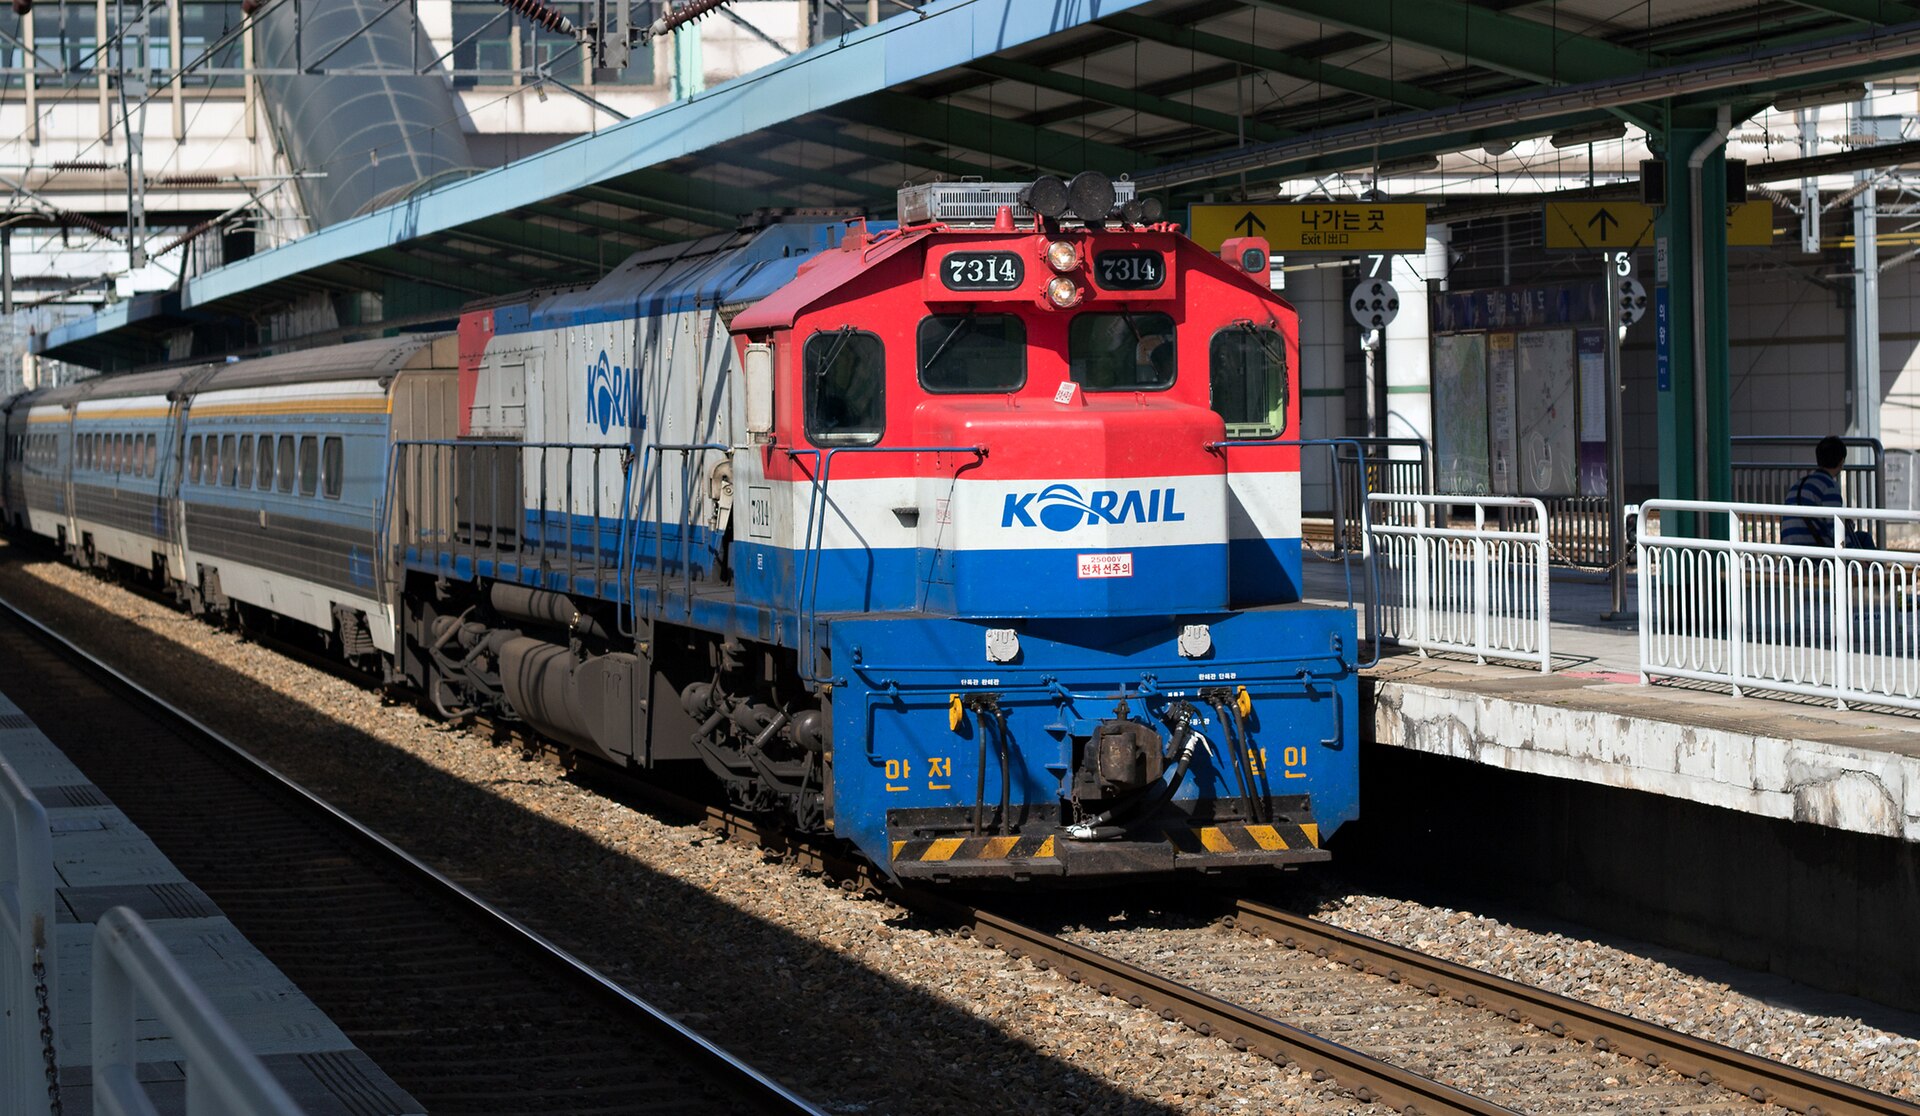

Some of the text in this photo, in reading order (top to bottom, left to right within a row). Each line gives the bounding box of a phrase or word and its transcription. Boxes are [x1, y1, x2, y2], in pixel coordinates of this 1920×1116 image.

[1301, 209, 1385, 231] 나가는 곳
[1301, 232, 1321, 245] Exit
[1327, 232, 1349, 245] 出口
[950, 256, 1016, 282] 7314
[1102, 257, 1155, 281] 7314
[1367, 254, 1384, 278] 7
[1614, 251, 1631, 277] 6
[587, 349, 647, 436] KORAIL
[751, 499, 769, 526] 7314
[1001, 483, 1185, 532] KORAIL
[1081, 562, 1130, 575] 전차선주의
[1090, 555, 1122, 563] 25000V
